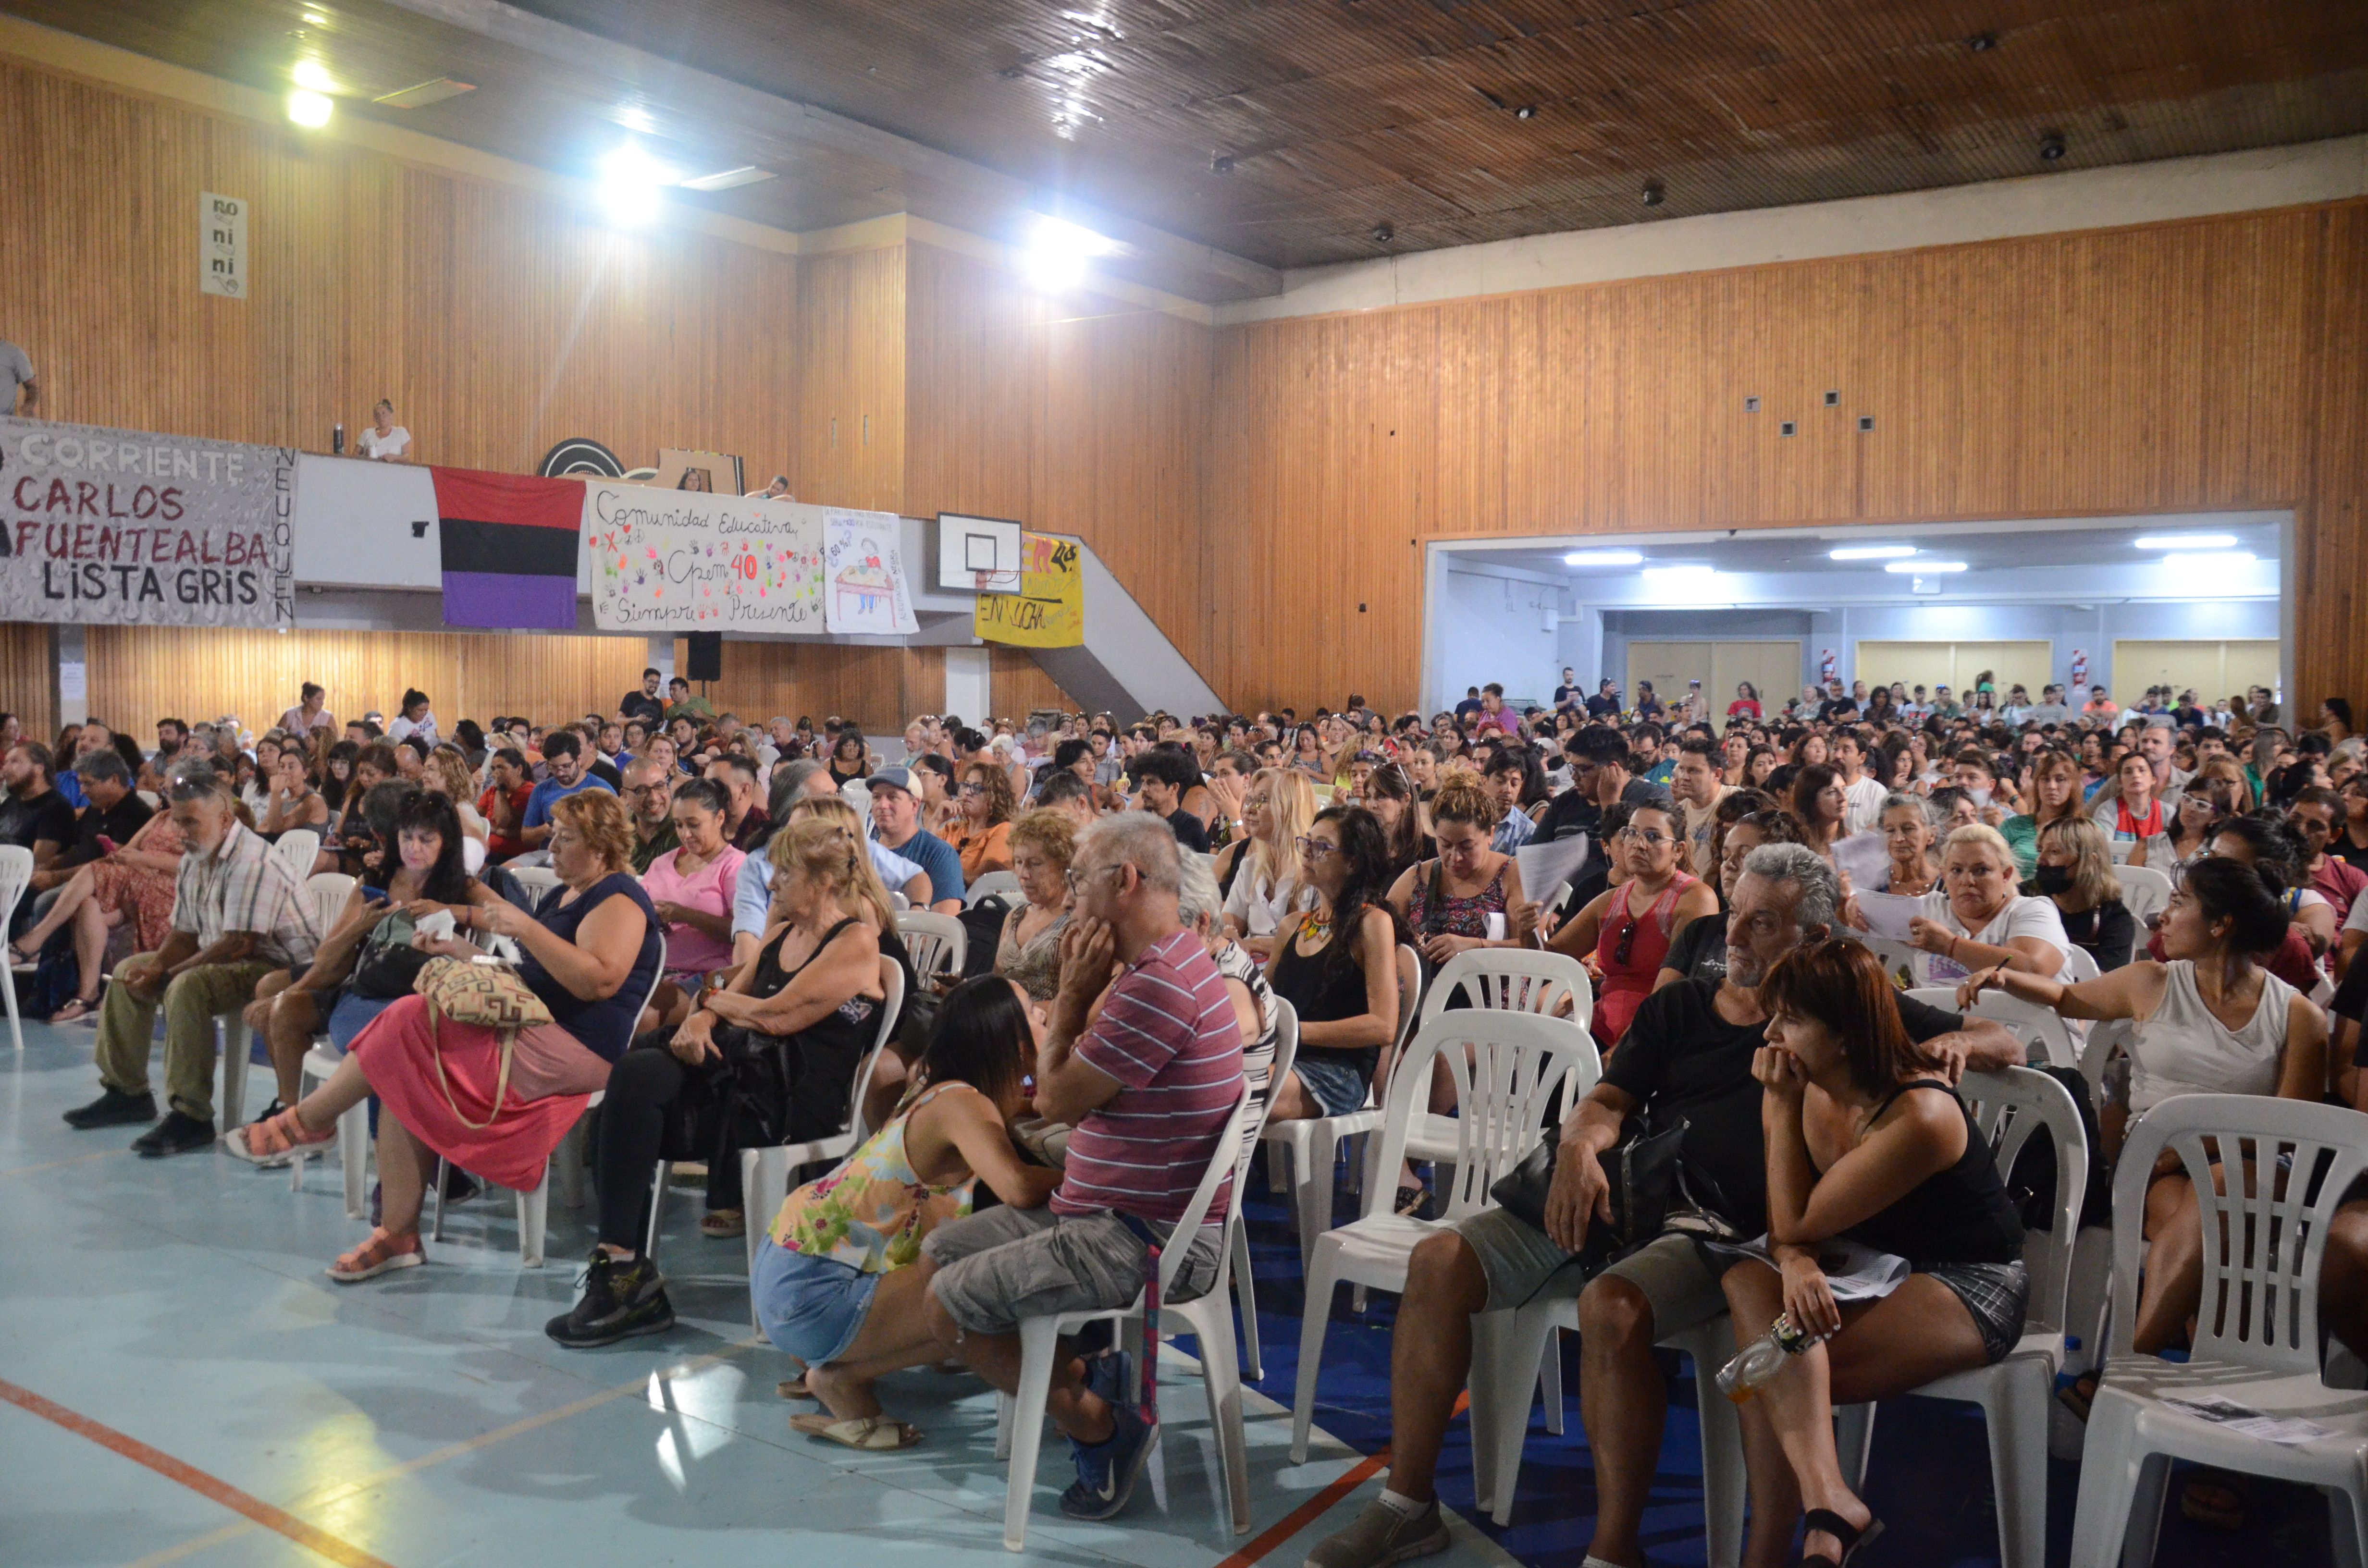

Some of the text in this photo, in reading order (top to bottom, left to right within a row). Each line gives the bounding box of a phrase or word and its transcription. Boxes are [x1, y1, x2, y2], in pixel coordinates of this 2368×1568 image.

[213, 199, 238, 216] no
[213, 228, 234, 244] ni
[212, 257, 234, 274] ni
[20, 433, 244, 482] CORRIENTE
[13, 476, 184, 520] CARLOS
[597, 490, 709, 526] Comunidad
[16, 521, 269, 568] FUENTEALBA
[730, 554, 757, 580] 40
[617, 594, 807, 627] Siempre Presente
